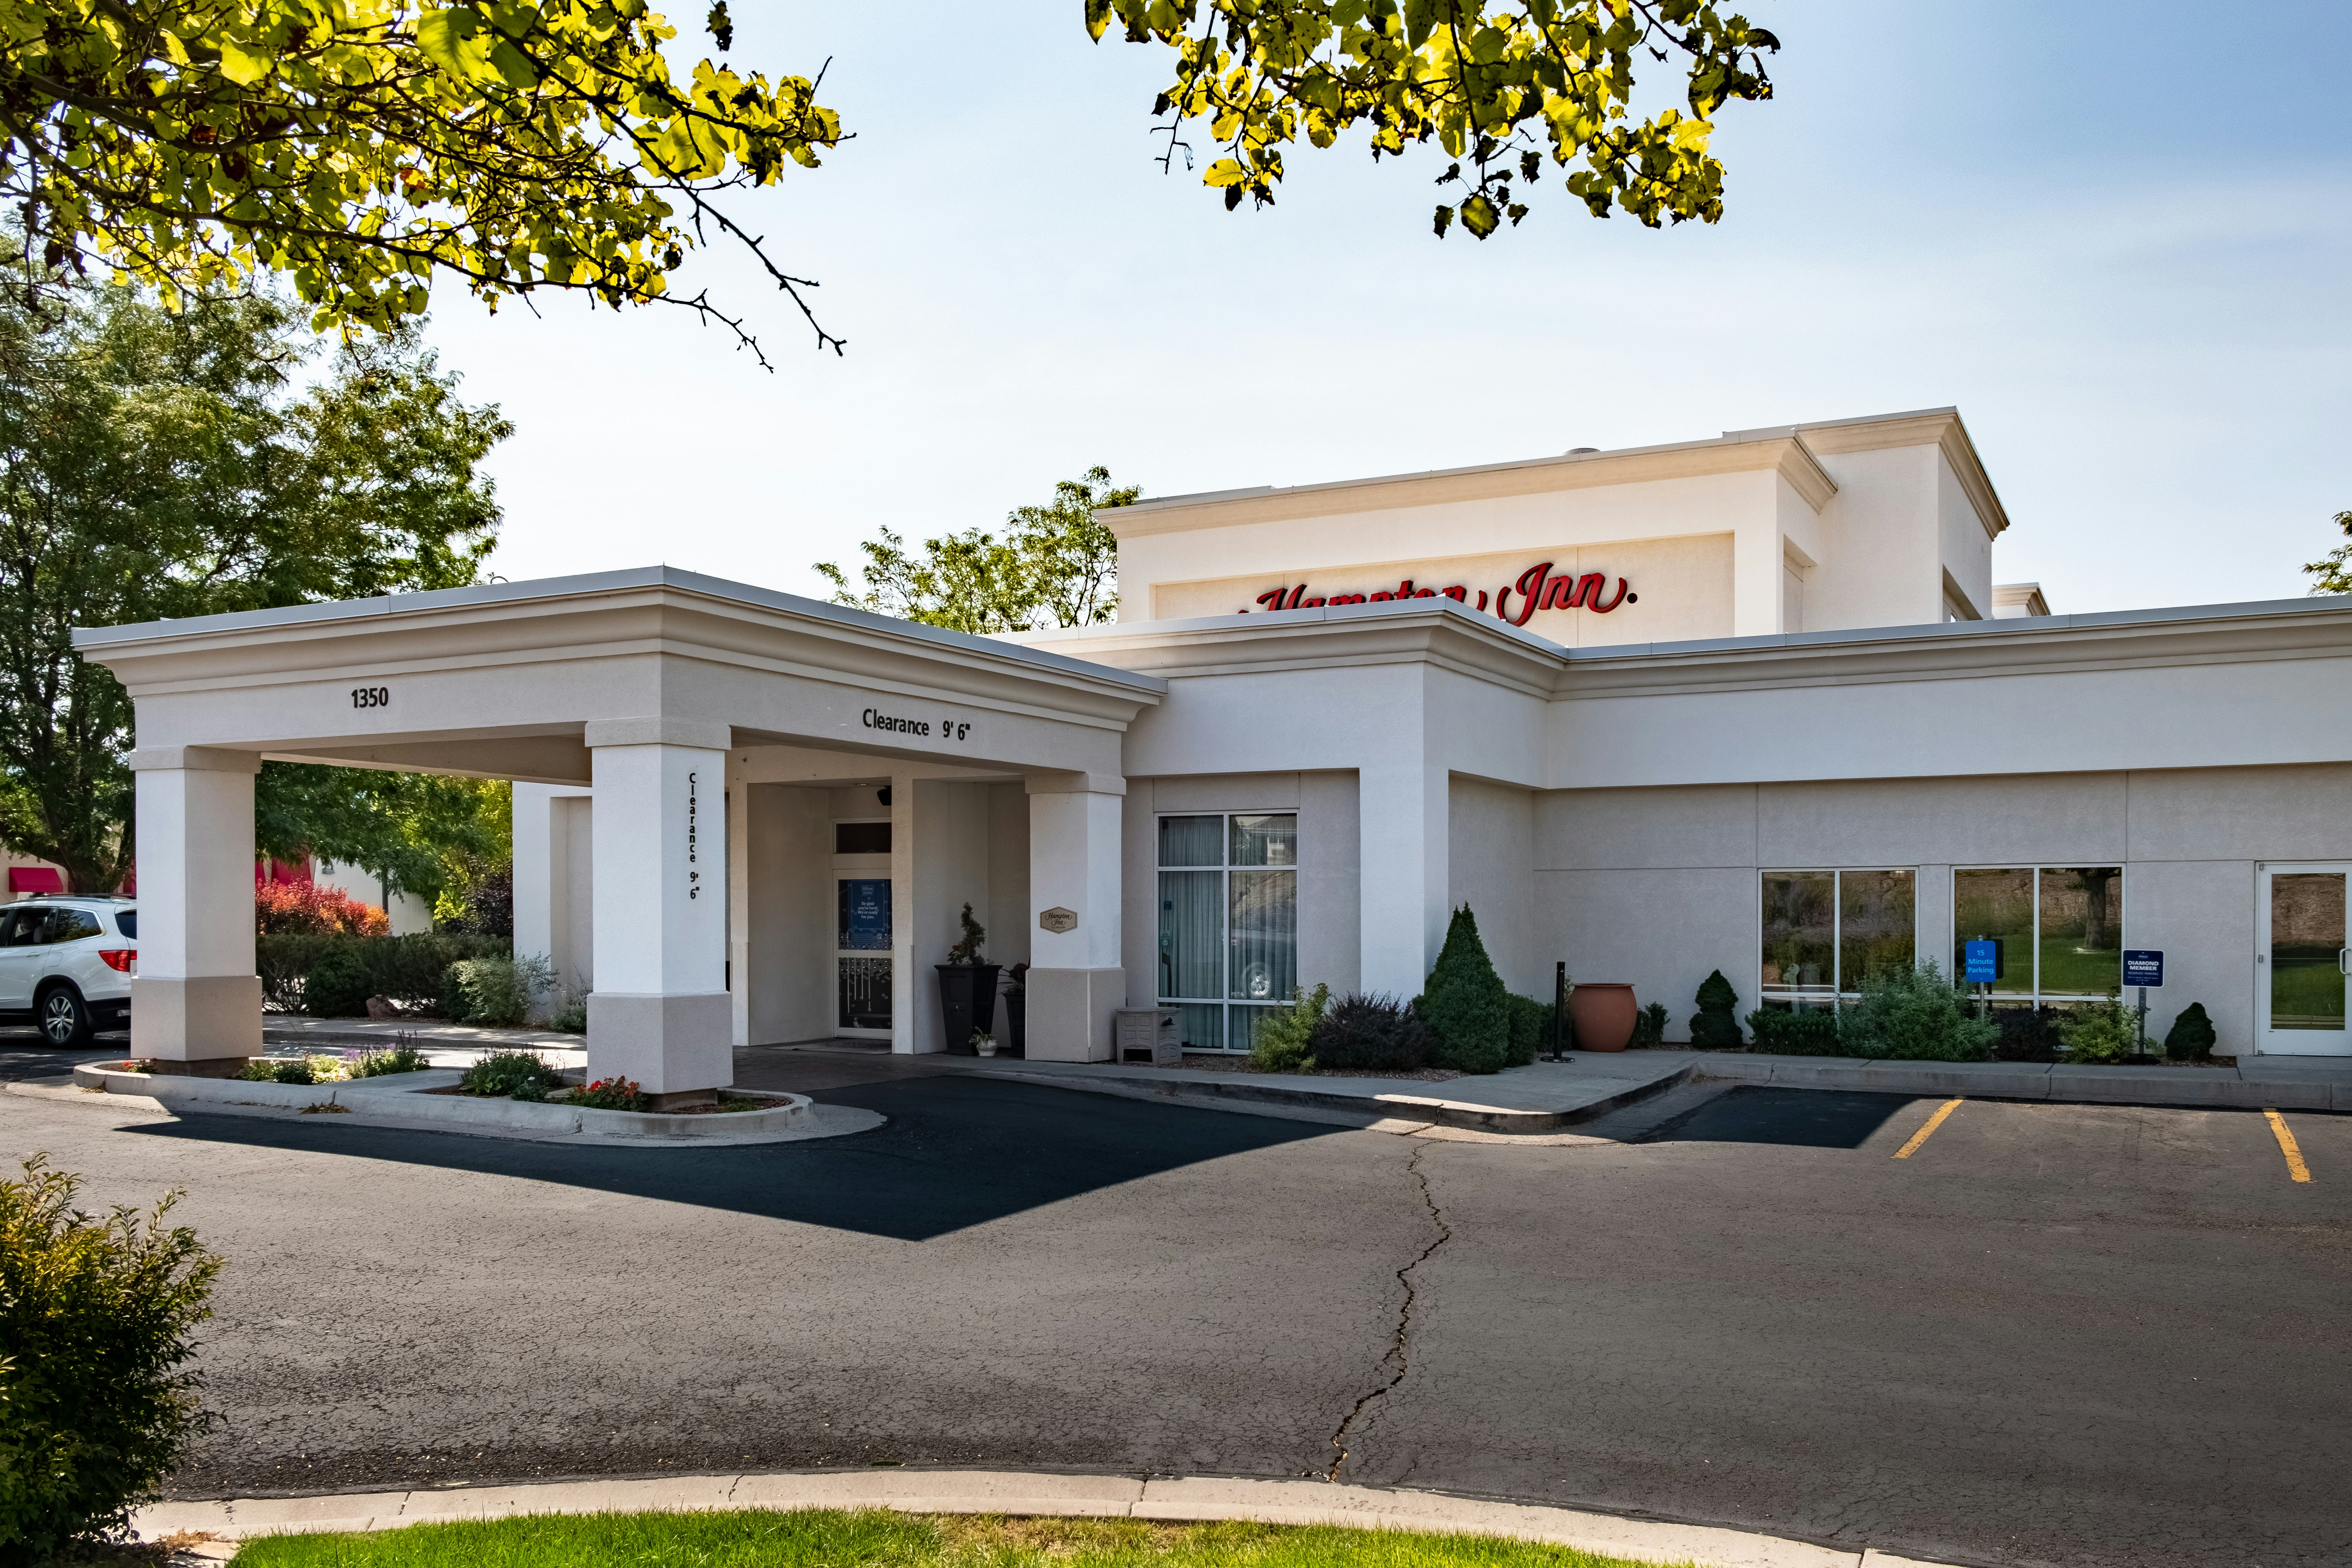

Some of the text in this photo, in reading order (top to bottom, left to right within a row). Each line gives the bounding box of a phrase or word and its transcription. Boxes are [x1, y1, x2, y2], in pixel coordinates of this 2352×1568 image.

[1496, 562, 1627, 627] Inn
[351, 687, 389, 708] 1350
[863, 708, 930, 736] Clearance
[943, 720, 954, 738] 9'
